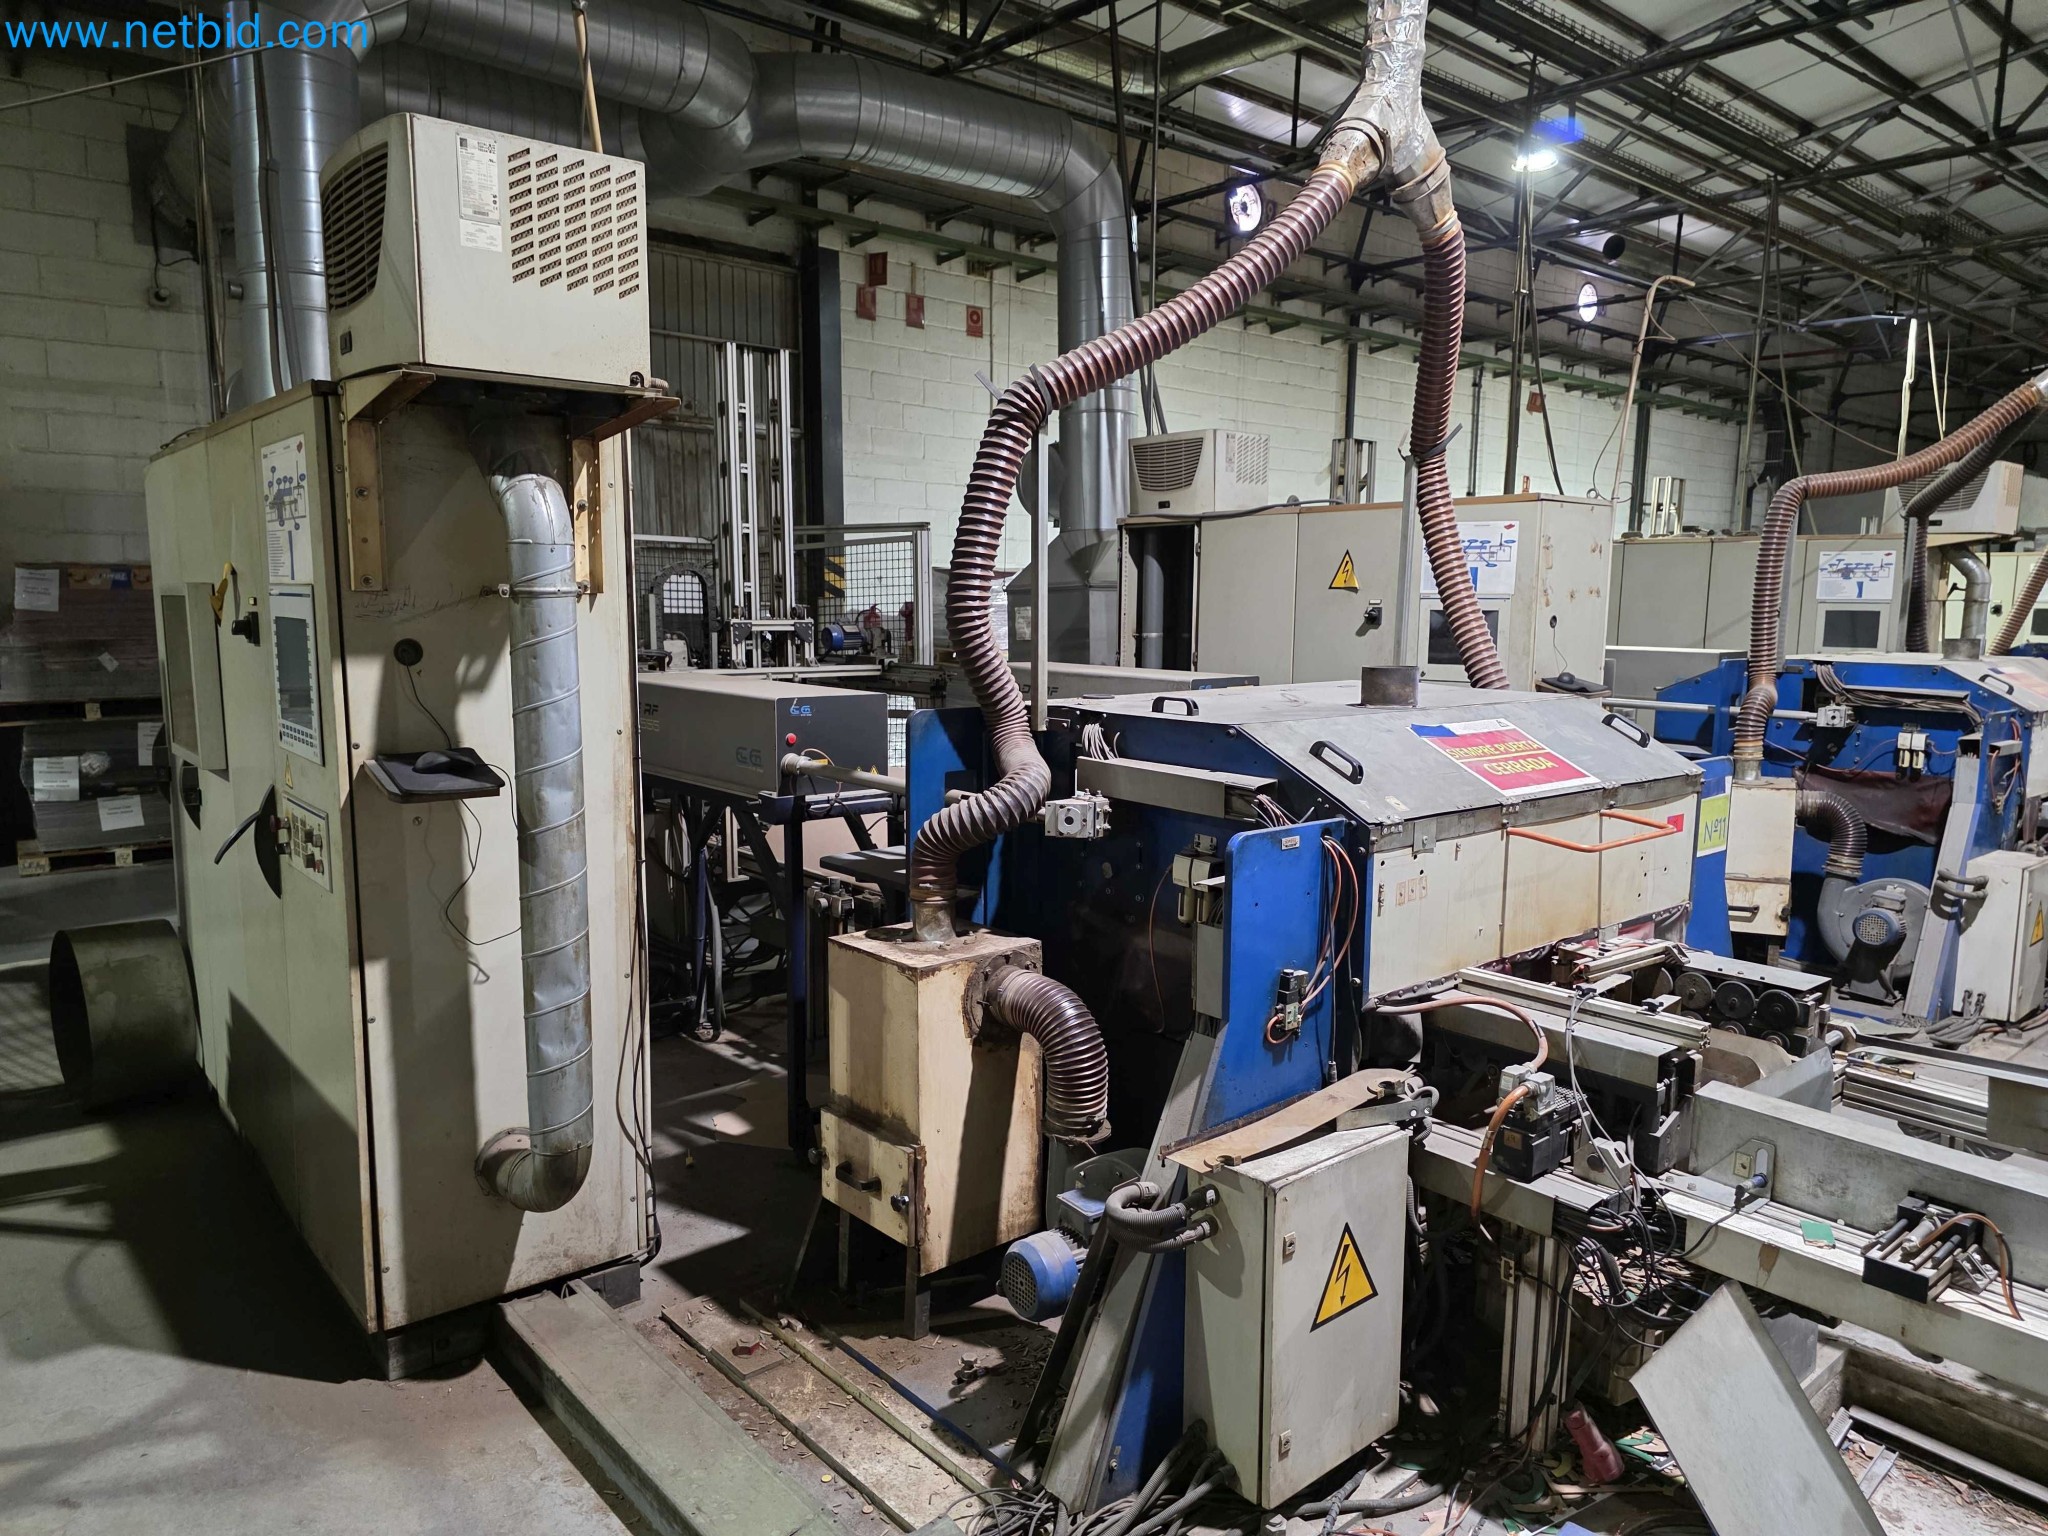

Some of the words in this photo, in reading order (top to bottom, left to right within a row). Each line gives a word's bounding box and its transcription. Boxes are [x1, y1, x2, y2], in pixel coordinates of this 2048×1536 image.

[1446, 743, 1496, 759] SIEMPRE
[1498, 740, 1543, 753] PUERTA
[1483, 757, 1558, 775] CERRADA
